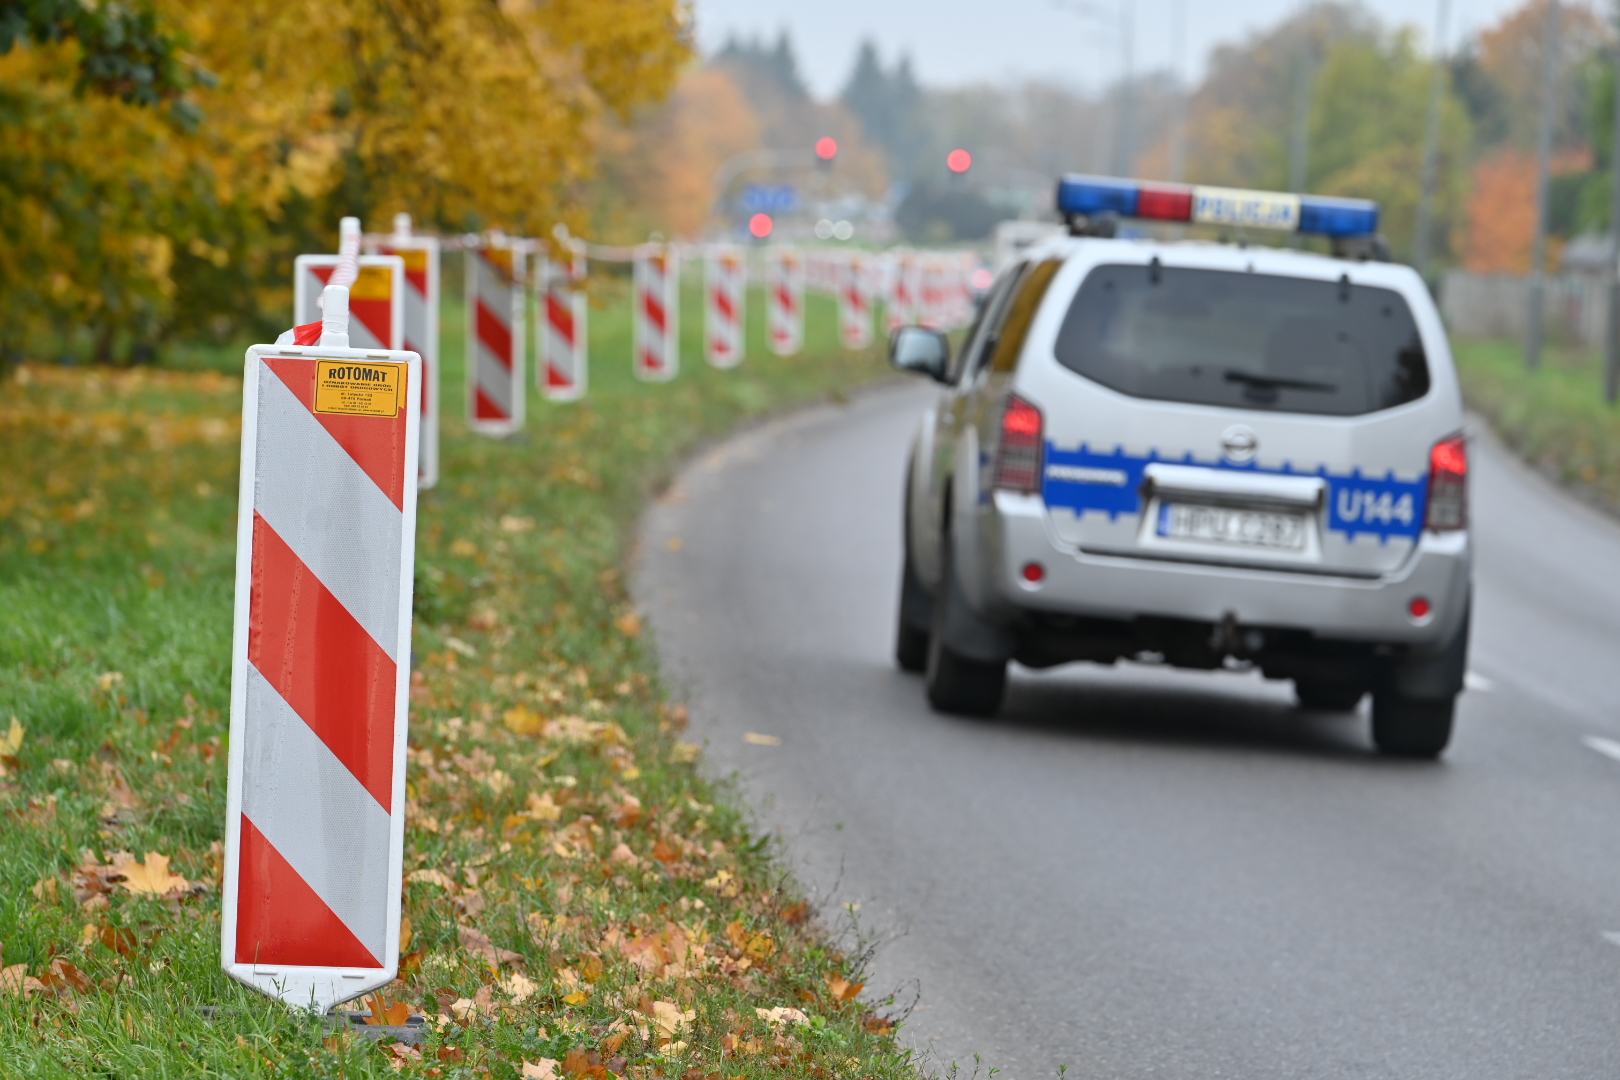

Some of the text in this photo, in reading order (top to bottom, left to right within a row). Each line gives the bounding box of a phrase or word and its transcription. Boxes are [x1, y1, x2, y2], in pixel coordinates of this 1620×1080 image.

[1195, 193, 1295, 226] POLICJA
[328, 367, 388, 382] ROTOMAT
[1336, 487, 1414, 527] U144
